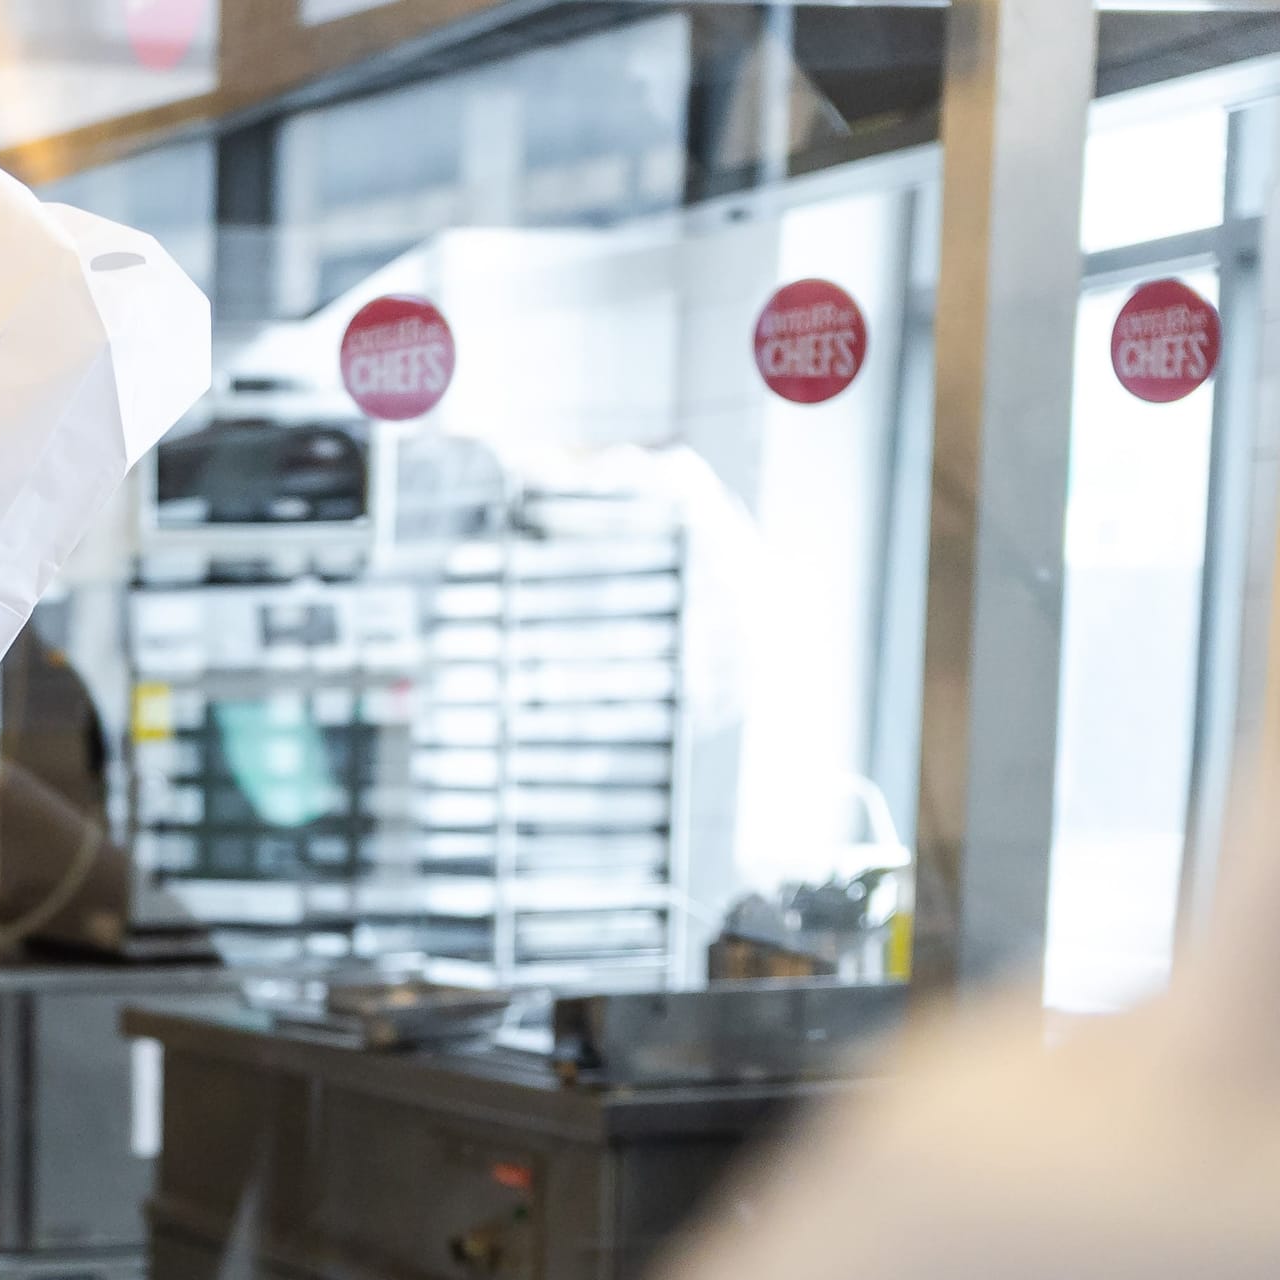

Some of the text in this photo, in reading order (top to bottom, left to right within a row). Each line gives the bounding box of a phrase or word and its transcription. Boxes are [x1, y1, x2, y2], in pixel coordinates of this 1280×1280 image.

[350, 343, 447, 394] CHEFS
[762, 329, 857, 377] CHEFS
[1118, 331, 1209, 379] CHEFS
